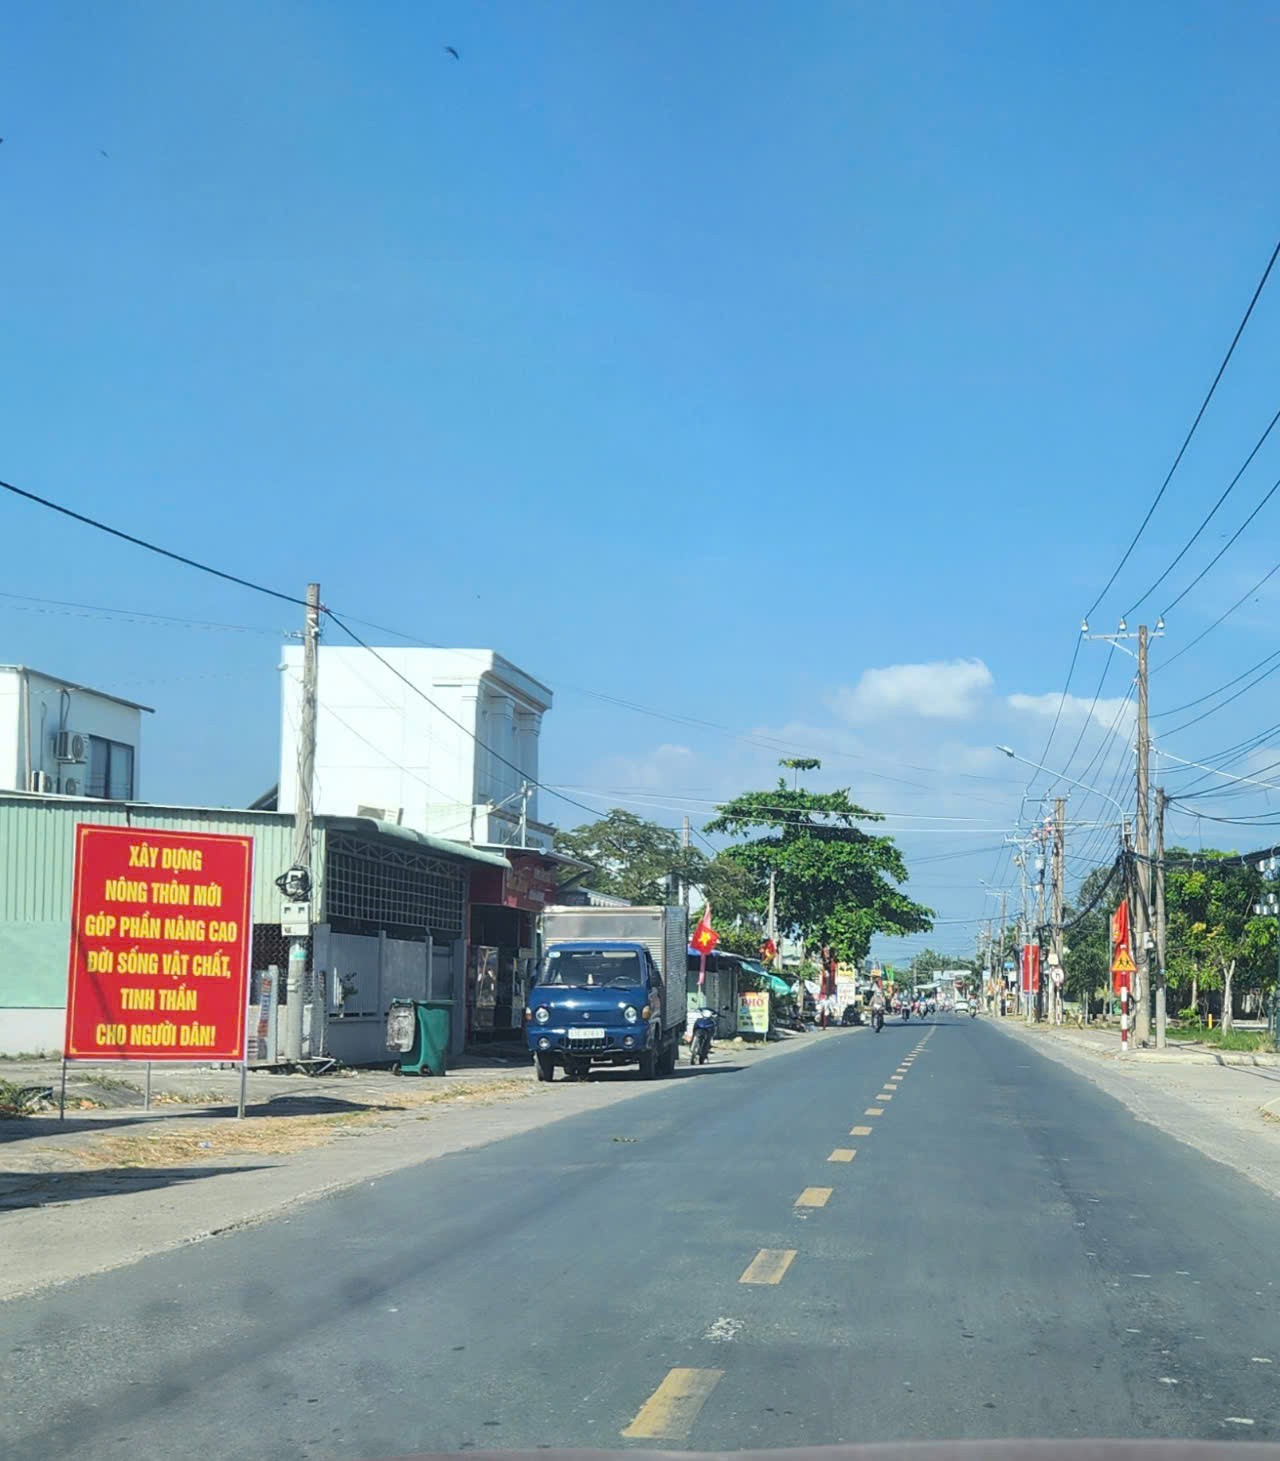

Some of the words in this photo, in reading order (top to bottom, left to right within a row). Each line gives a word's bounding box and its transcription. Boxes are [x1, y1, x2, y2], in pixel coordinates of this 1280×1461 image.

[129, 843, 159, 868] XÂY
[161, 848, 203, 872] DỰNG
[105, 876, 148, 903] NÔNG
[151, 880, 191, 905] THÔN
[193, 883, 222, 907] MỚI
[84, 912, 117, 937] GÓP
[119, 912, 161, 939] PHẦN
[164, 915, 206, 942] NÂNG
[208, 920, 238, 943] CAO
[87, 949, 114, 973] ĐỜI
[117, 948, 159, 975] SỐNG
[162, 952, 190, 977] VẬT
[192, 952, 231, 977] CHẤT,
[120, 988, 156, 1011] TINH
[158, 985, 197, 1011] THẦN
[95, 1023, 127, 1046] CHO
[129, 1021, 177, 1047] NGƯỜI
[179, 1023, 216, 1047] DÂN!
